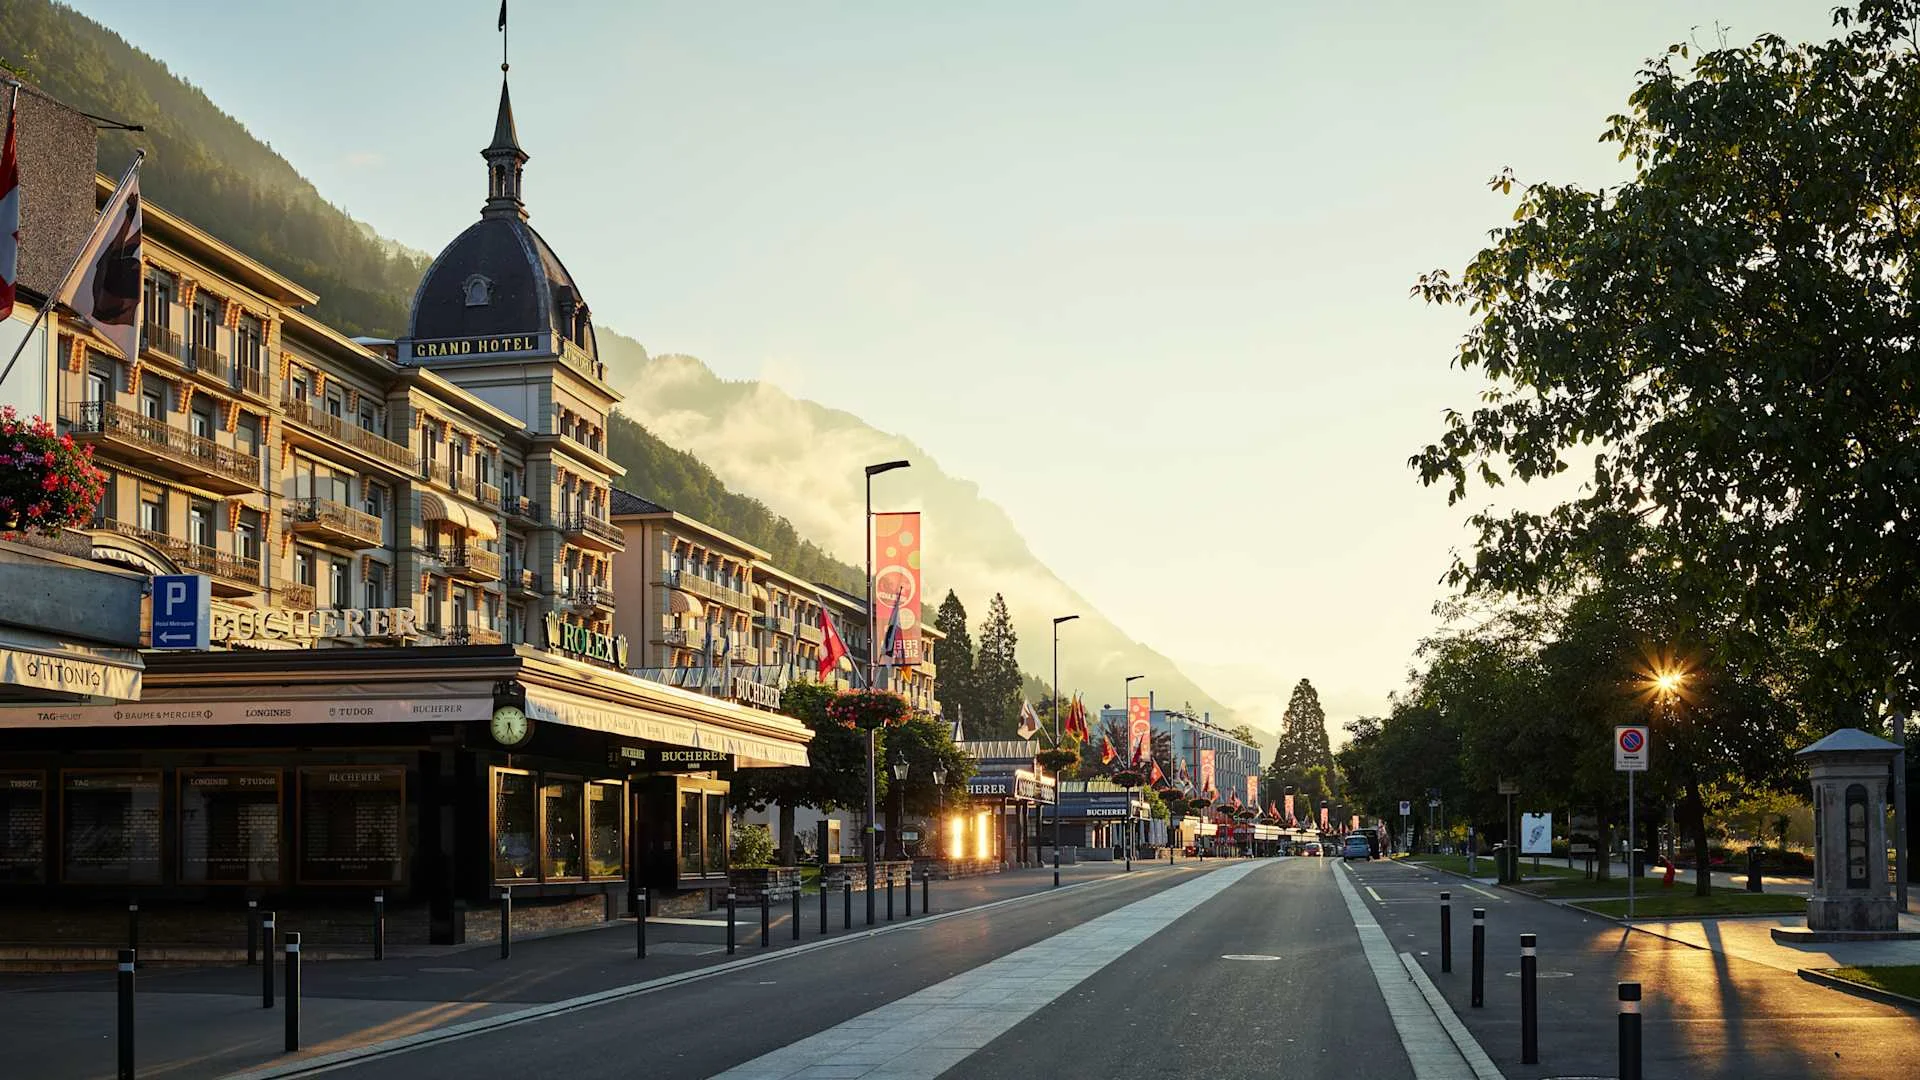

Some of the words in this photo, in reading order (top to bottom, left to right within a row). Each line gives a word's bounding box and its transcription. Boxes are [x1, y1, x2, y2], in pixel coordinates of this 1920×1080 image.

[417, 340, 471, 357] GRAND
[478, 336, 533, 353] HOTEL
[166, 581, 187, 616] P
[210, 607, 421, 641] BUCHERER
[563, 623, 615, 663] ROLEX
[40, 662, 89, 686] TITONI
[736, 677, 781, 709] BUCHERER
[245, 709, 291, 718] LONGINES
[339, 707, 374, 716] TUDOR
[412, 704, 462, 713] BUCHERER
[661, 750, 727, 761] BUCHERER
[965, 784, 1007, 794] HERER
[1086, 808, 1127, 816] BUCHERER
